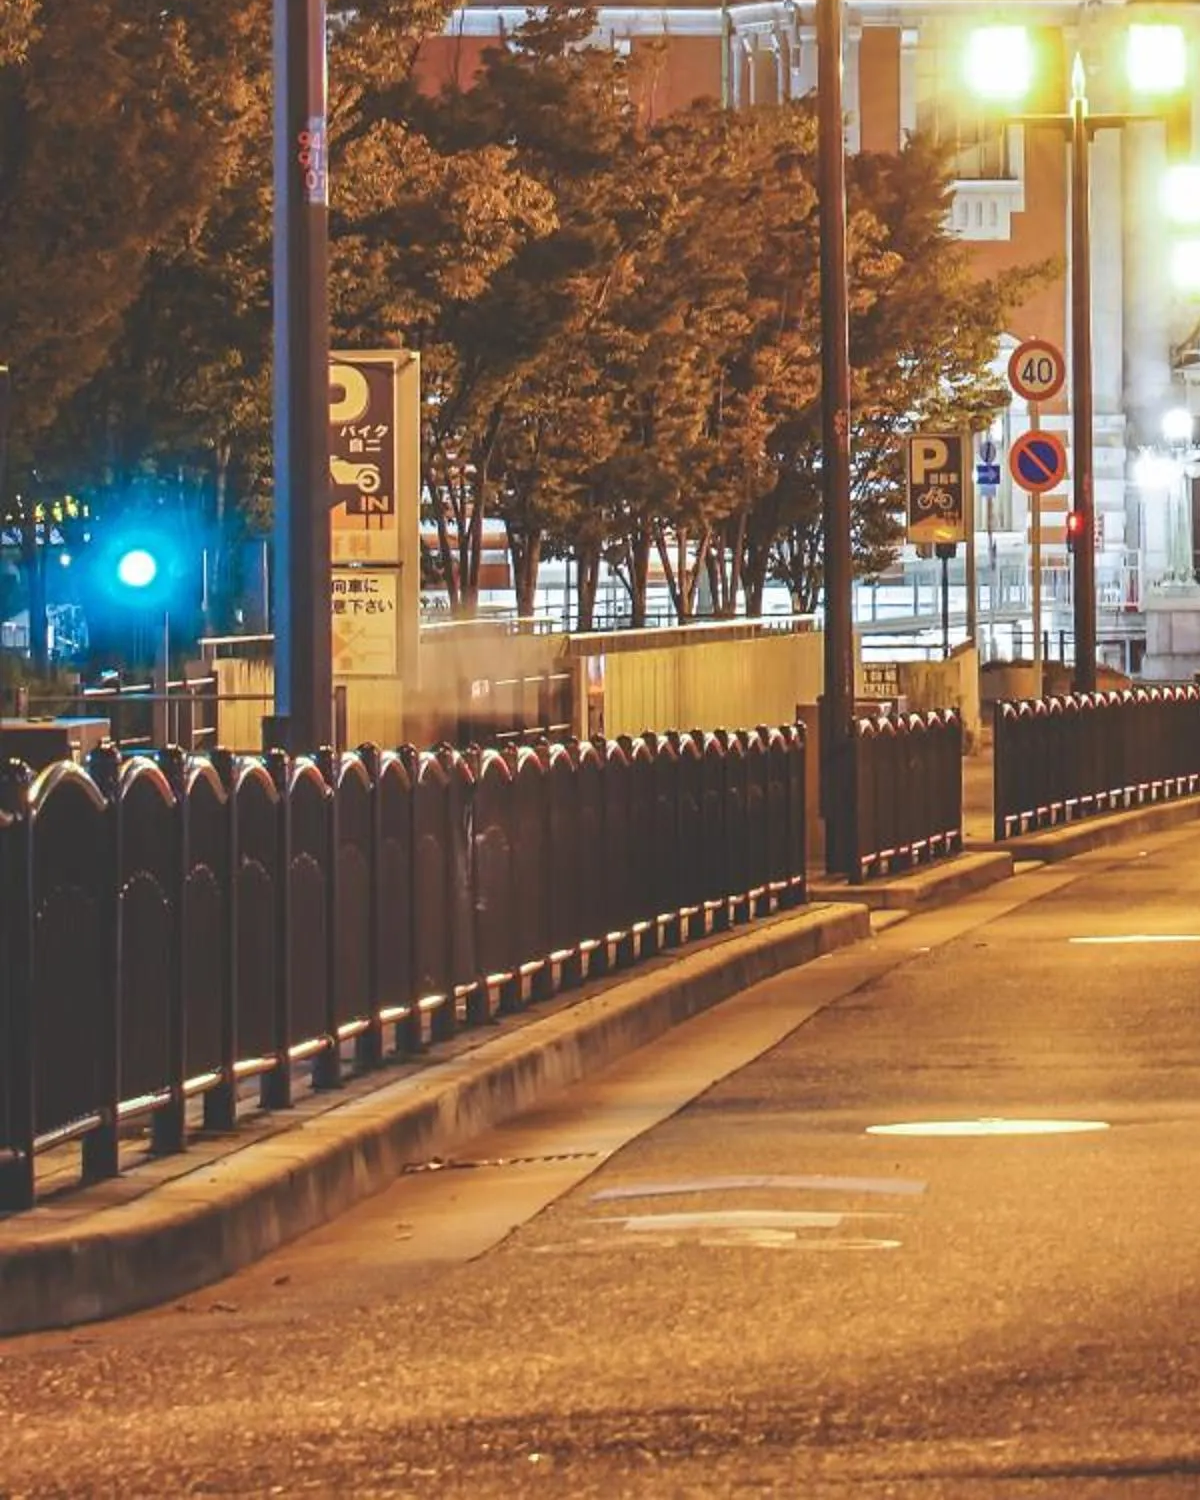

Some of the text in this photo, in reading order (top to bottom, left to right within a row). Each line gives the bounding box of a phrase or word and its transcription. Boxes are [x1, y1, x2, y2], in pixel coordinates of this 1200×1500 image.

[1022, 357, 1052, 385] 40
[340, 424, 389, 438] バイク
[912, 439, 948, 484] P
[361, 495, 389, 512] IN
